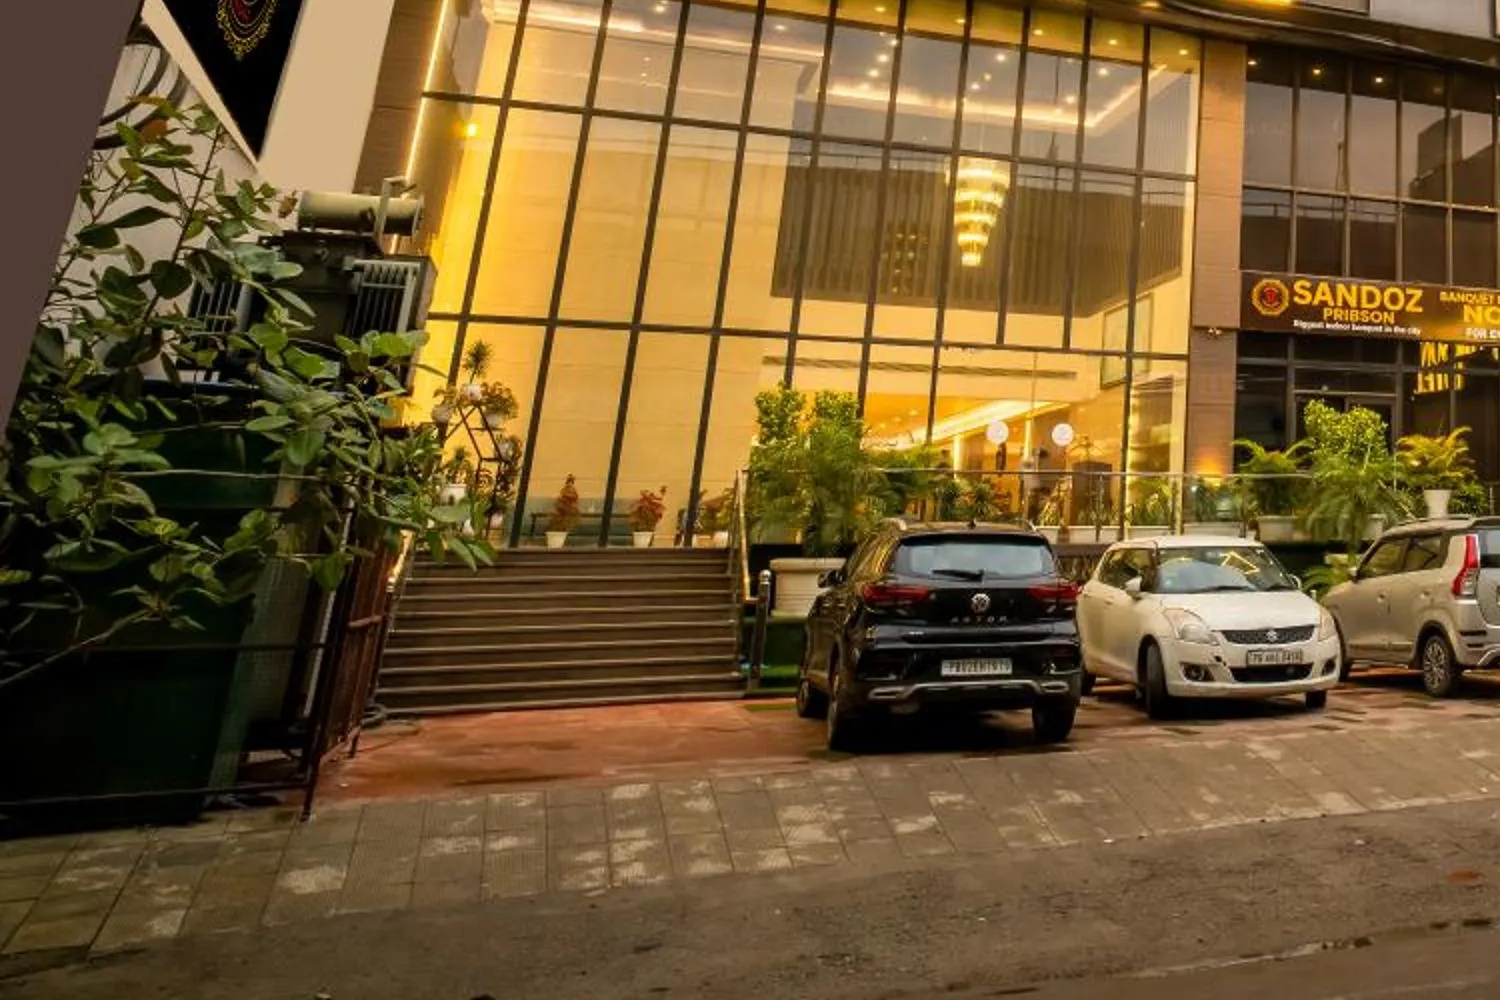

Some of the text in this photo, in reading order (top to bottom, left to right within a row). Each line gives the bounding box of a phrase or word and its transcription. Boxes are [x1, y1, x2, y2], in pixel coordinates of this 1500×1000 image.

[1292, 279, 1424, 313] SANDOZ
[1440, 291, 1494, 305] BANQUET
[1323, 307, 1396, 324] PRIBSON
[1465, 327, 1487, 339] FOR
